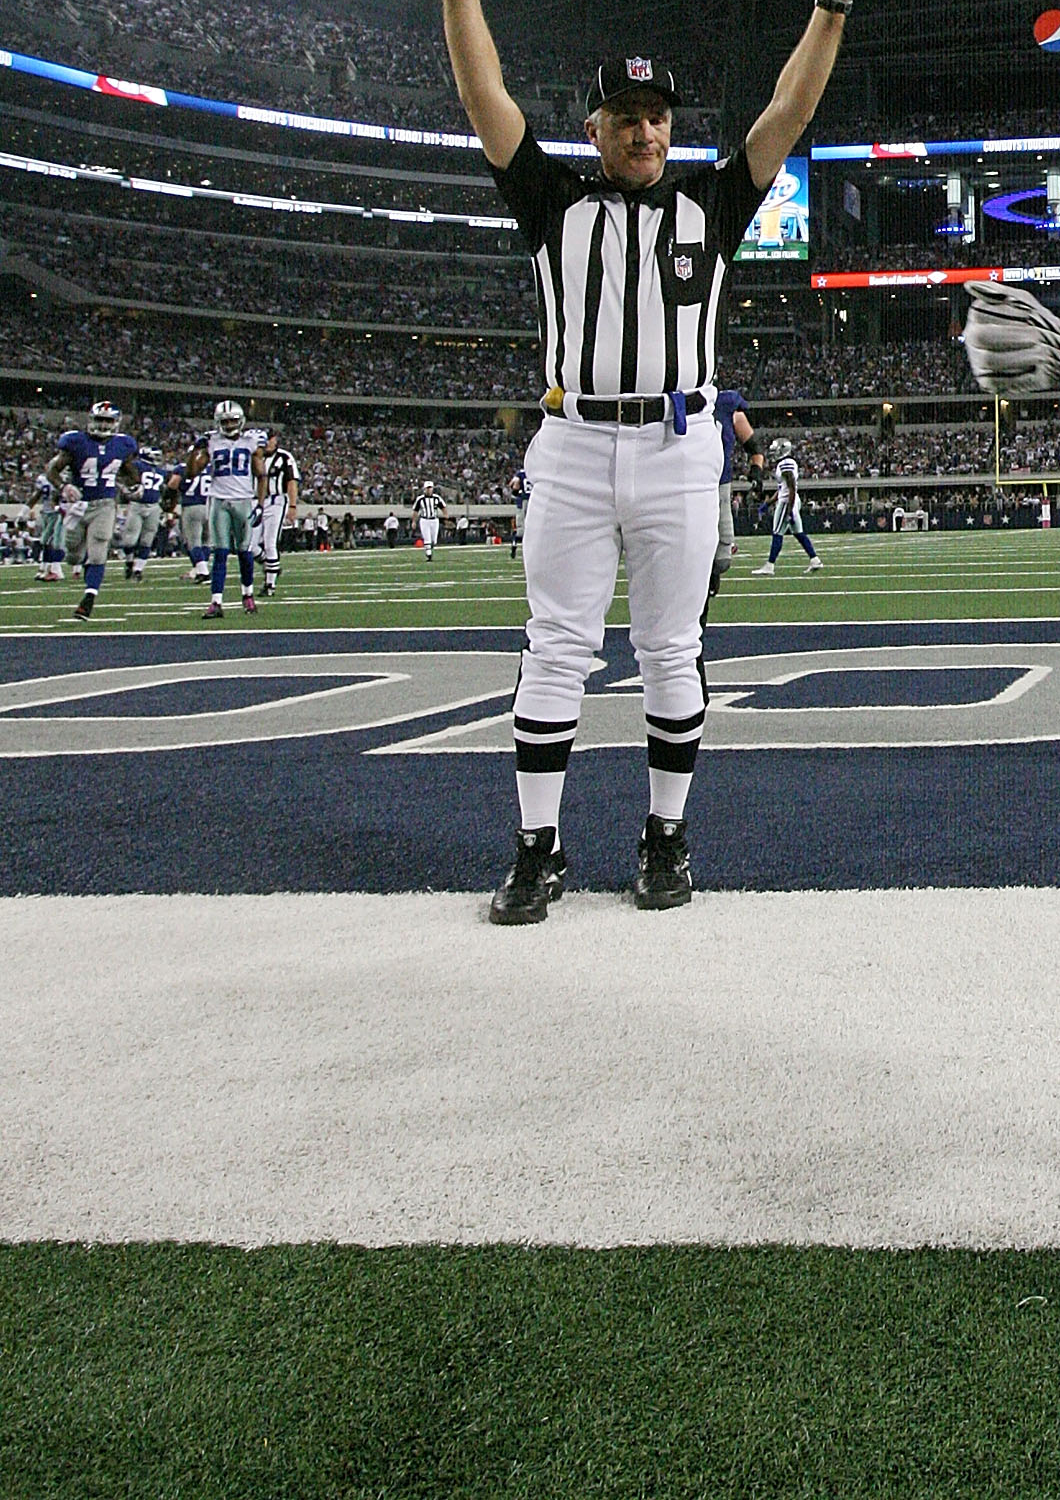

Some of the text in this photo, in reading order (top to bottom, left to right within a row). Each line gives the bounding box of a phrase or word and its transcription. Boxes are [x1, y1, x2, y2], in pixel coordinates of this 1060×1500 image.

[238, 105, 287, 126] COWBOYS
[288, 113, 350, 135] TOUCHDOWN
[351, 123, 386, 140] TRAVEL
[423, 131, 468, 148] 511-2005
[983, 139, 1023, 152] COWBOYS
[80, 457, 123, 488] 44
[212, 449, 251, 477] 20
[142, 472, 164, 490] 67
[184, 475, 212, 497] 76
